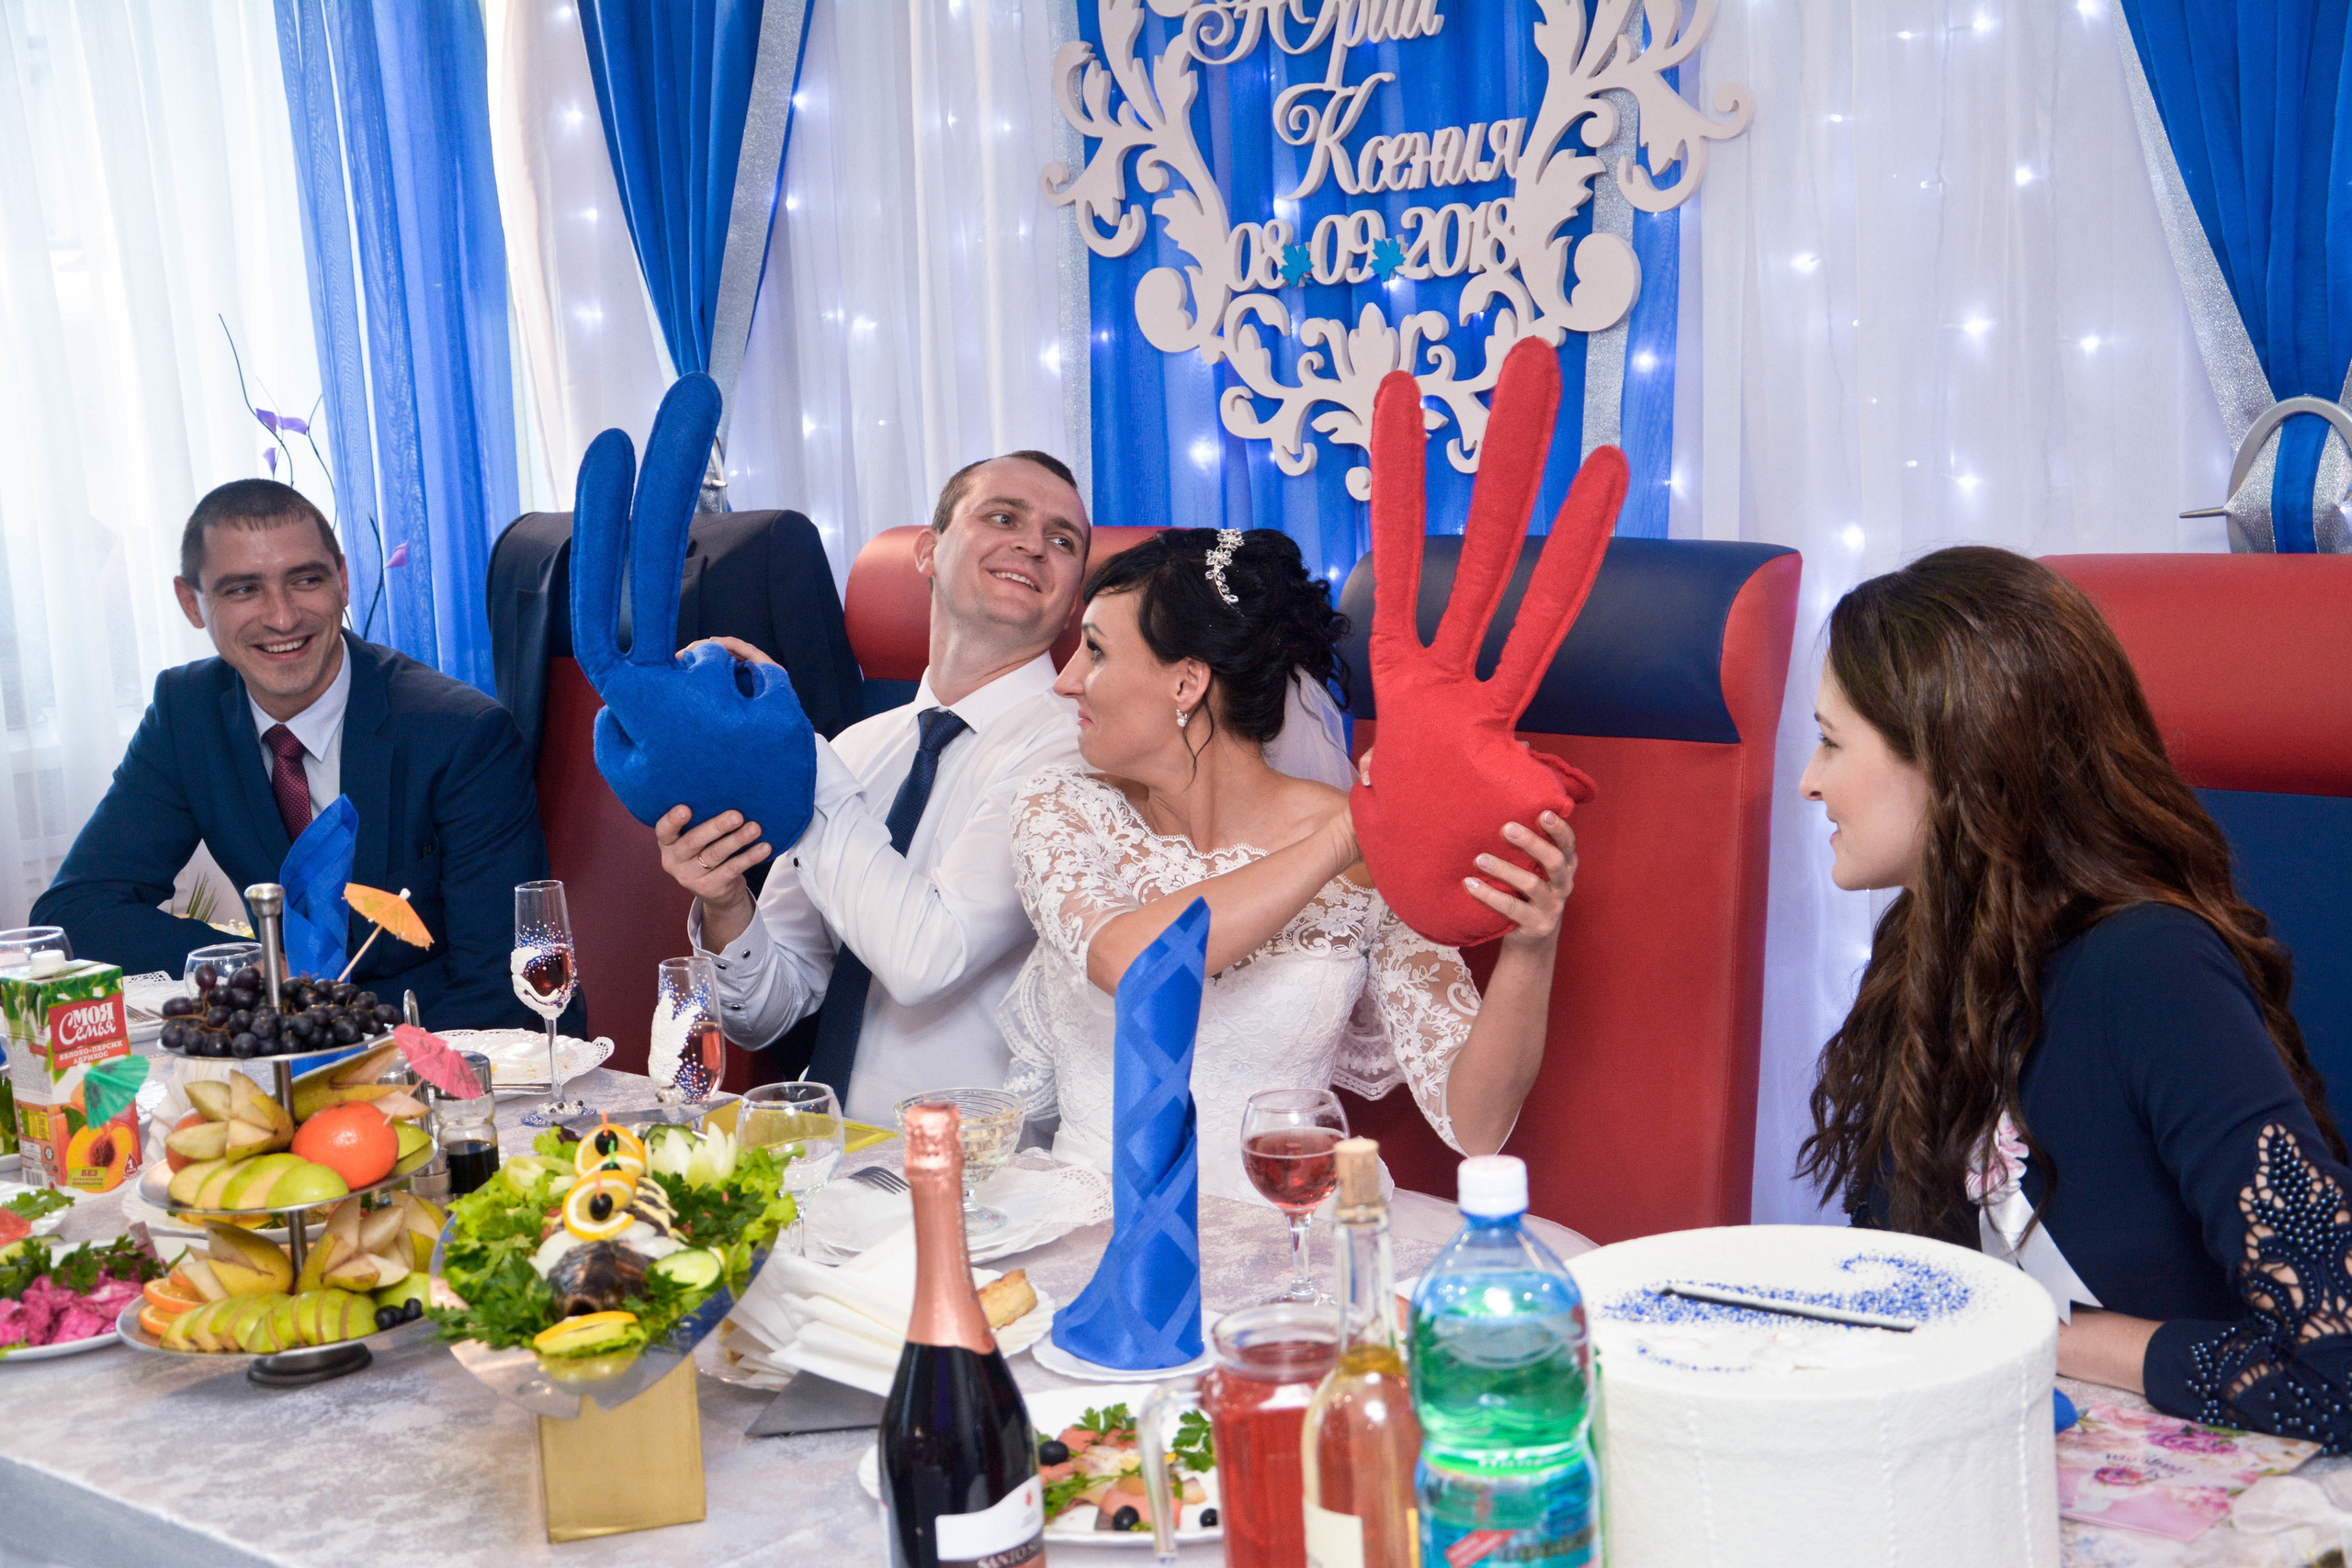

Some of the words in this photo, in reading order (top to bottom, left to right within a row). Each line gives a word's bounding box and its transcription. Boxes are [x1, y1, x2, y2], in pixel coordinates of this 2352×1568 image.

[1272, 72, 1527, 199] Ксения
[59, 1012, 116, 1045] Семья
[72, 1001, 115, 1028] МОЯ
